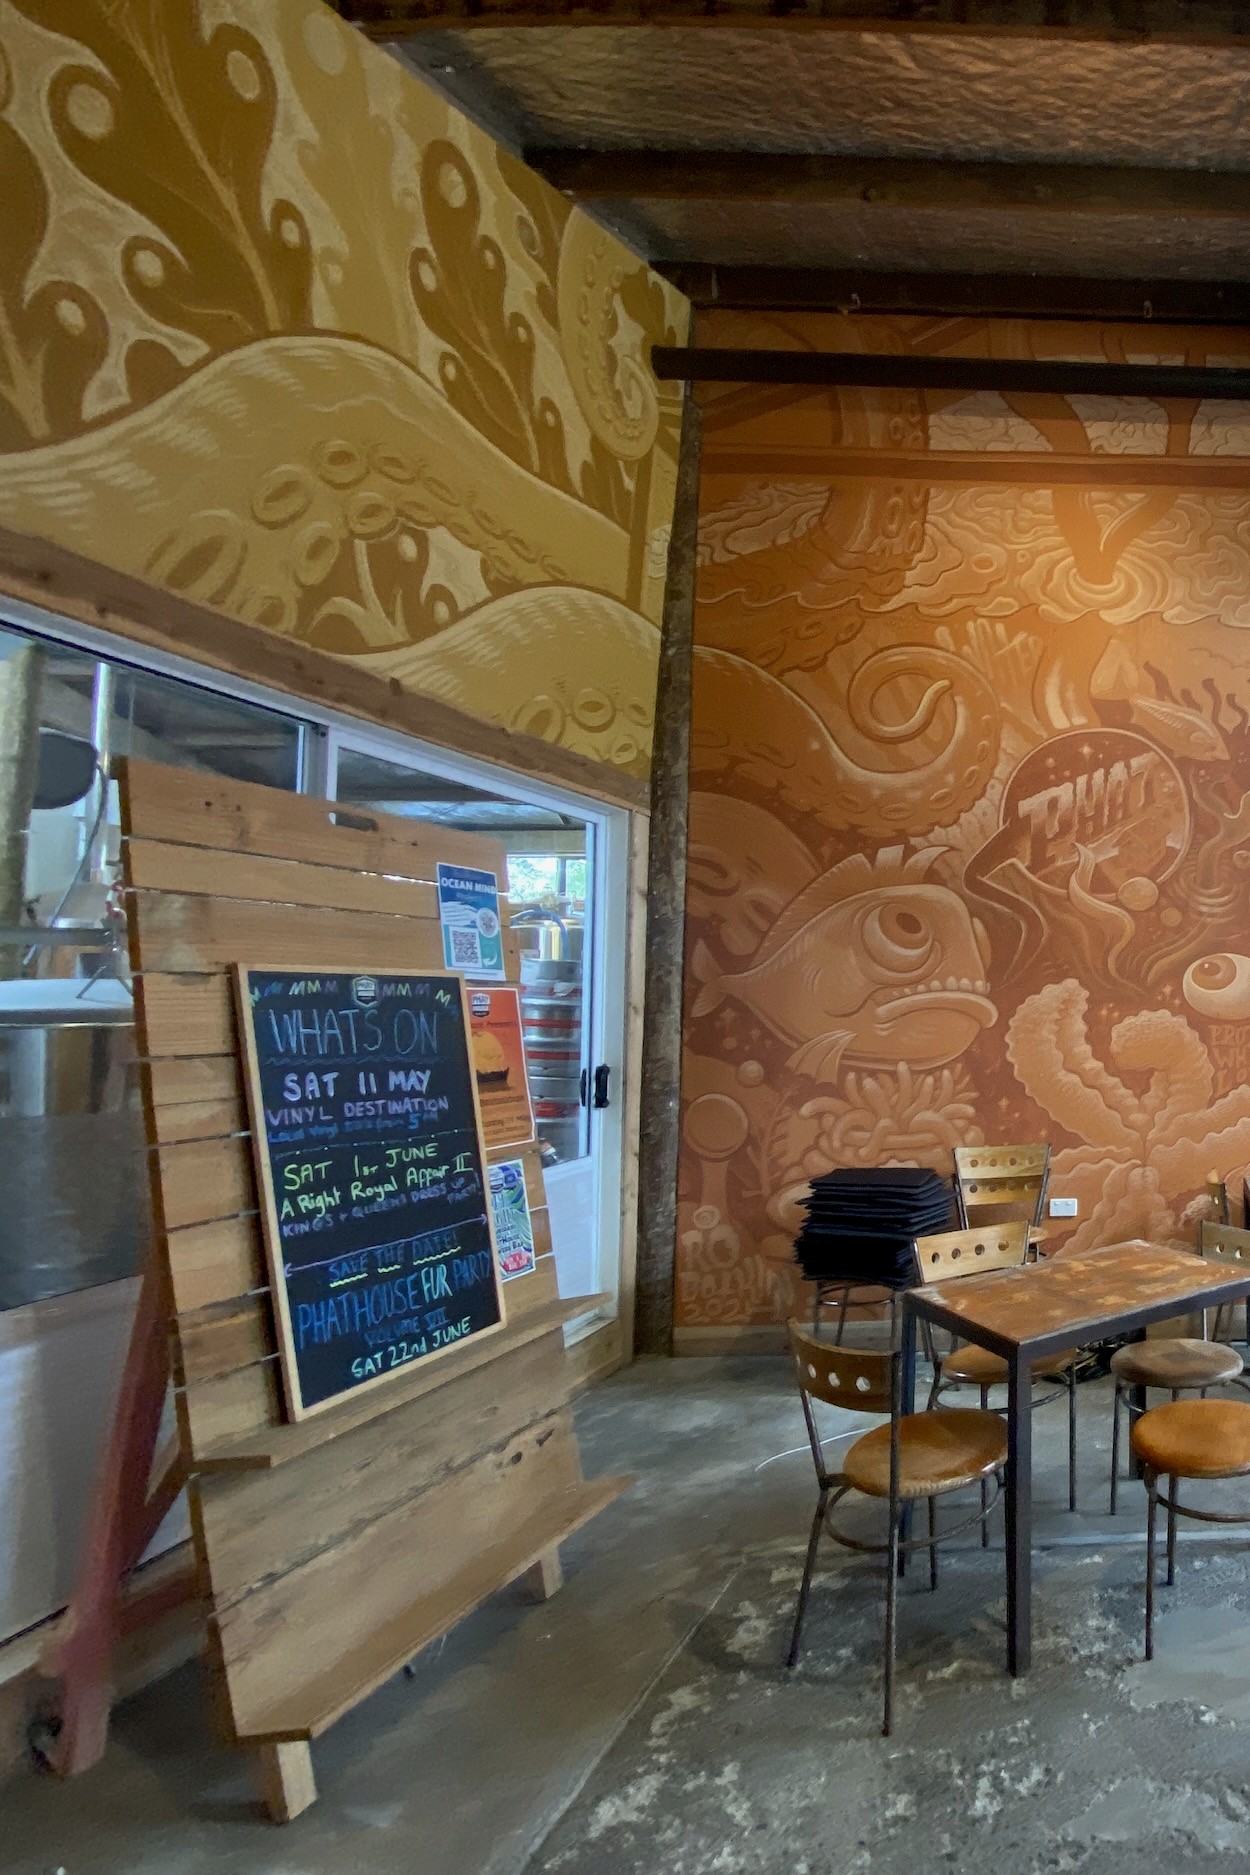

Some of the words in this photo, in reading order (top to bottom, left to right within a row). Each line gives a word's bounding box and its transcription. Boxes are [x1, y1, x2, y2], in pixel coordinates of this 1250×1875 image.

[441, 877, 474, 891] OCEAN
[268, 1008, 382, 1055] WHATS
[393, 1008, 438, 1055] ON
[283, 1071, 340, 1101] SAT
[388, 1068, 432, 1094] MAY
[266, 1105, 334, 1127] VINYL
[343, 1095, 450, 1118] DESTINATION
[283, 1160, 333, 1191] SAT
[384, 1142, 439, 1168] JUNE
[280, 1198, 296, 1222] A
[297, 1185, 342, 1218] Right
[349, 1175, 399, 1201] Royal
[405, 1164, 451, 1189] Affair
[328, 1252, 370, 1282] SAVE
[375, 1239, 406, 1266] THE
[420, 1263, 453, 1304] FUR
[451, 1250, 492, 1290] PARTY
[350, 1351, 383, 1379] SAT
[386, 1336, 428, 1368] 22nd
[431, 1315, 472, 1348] JUNE
